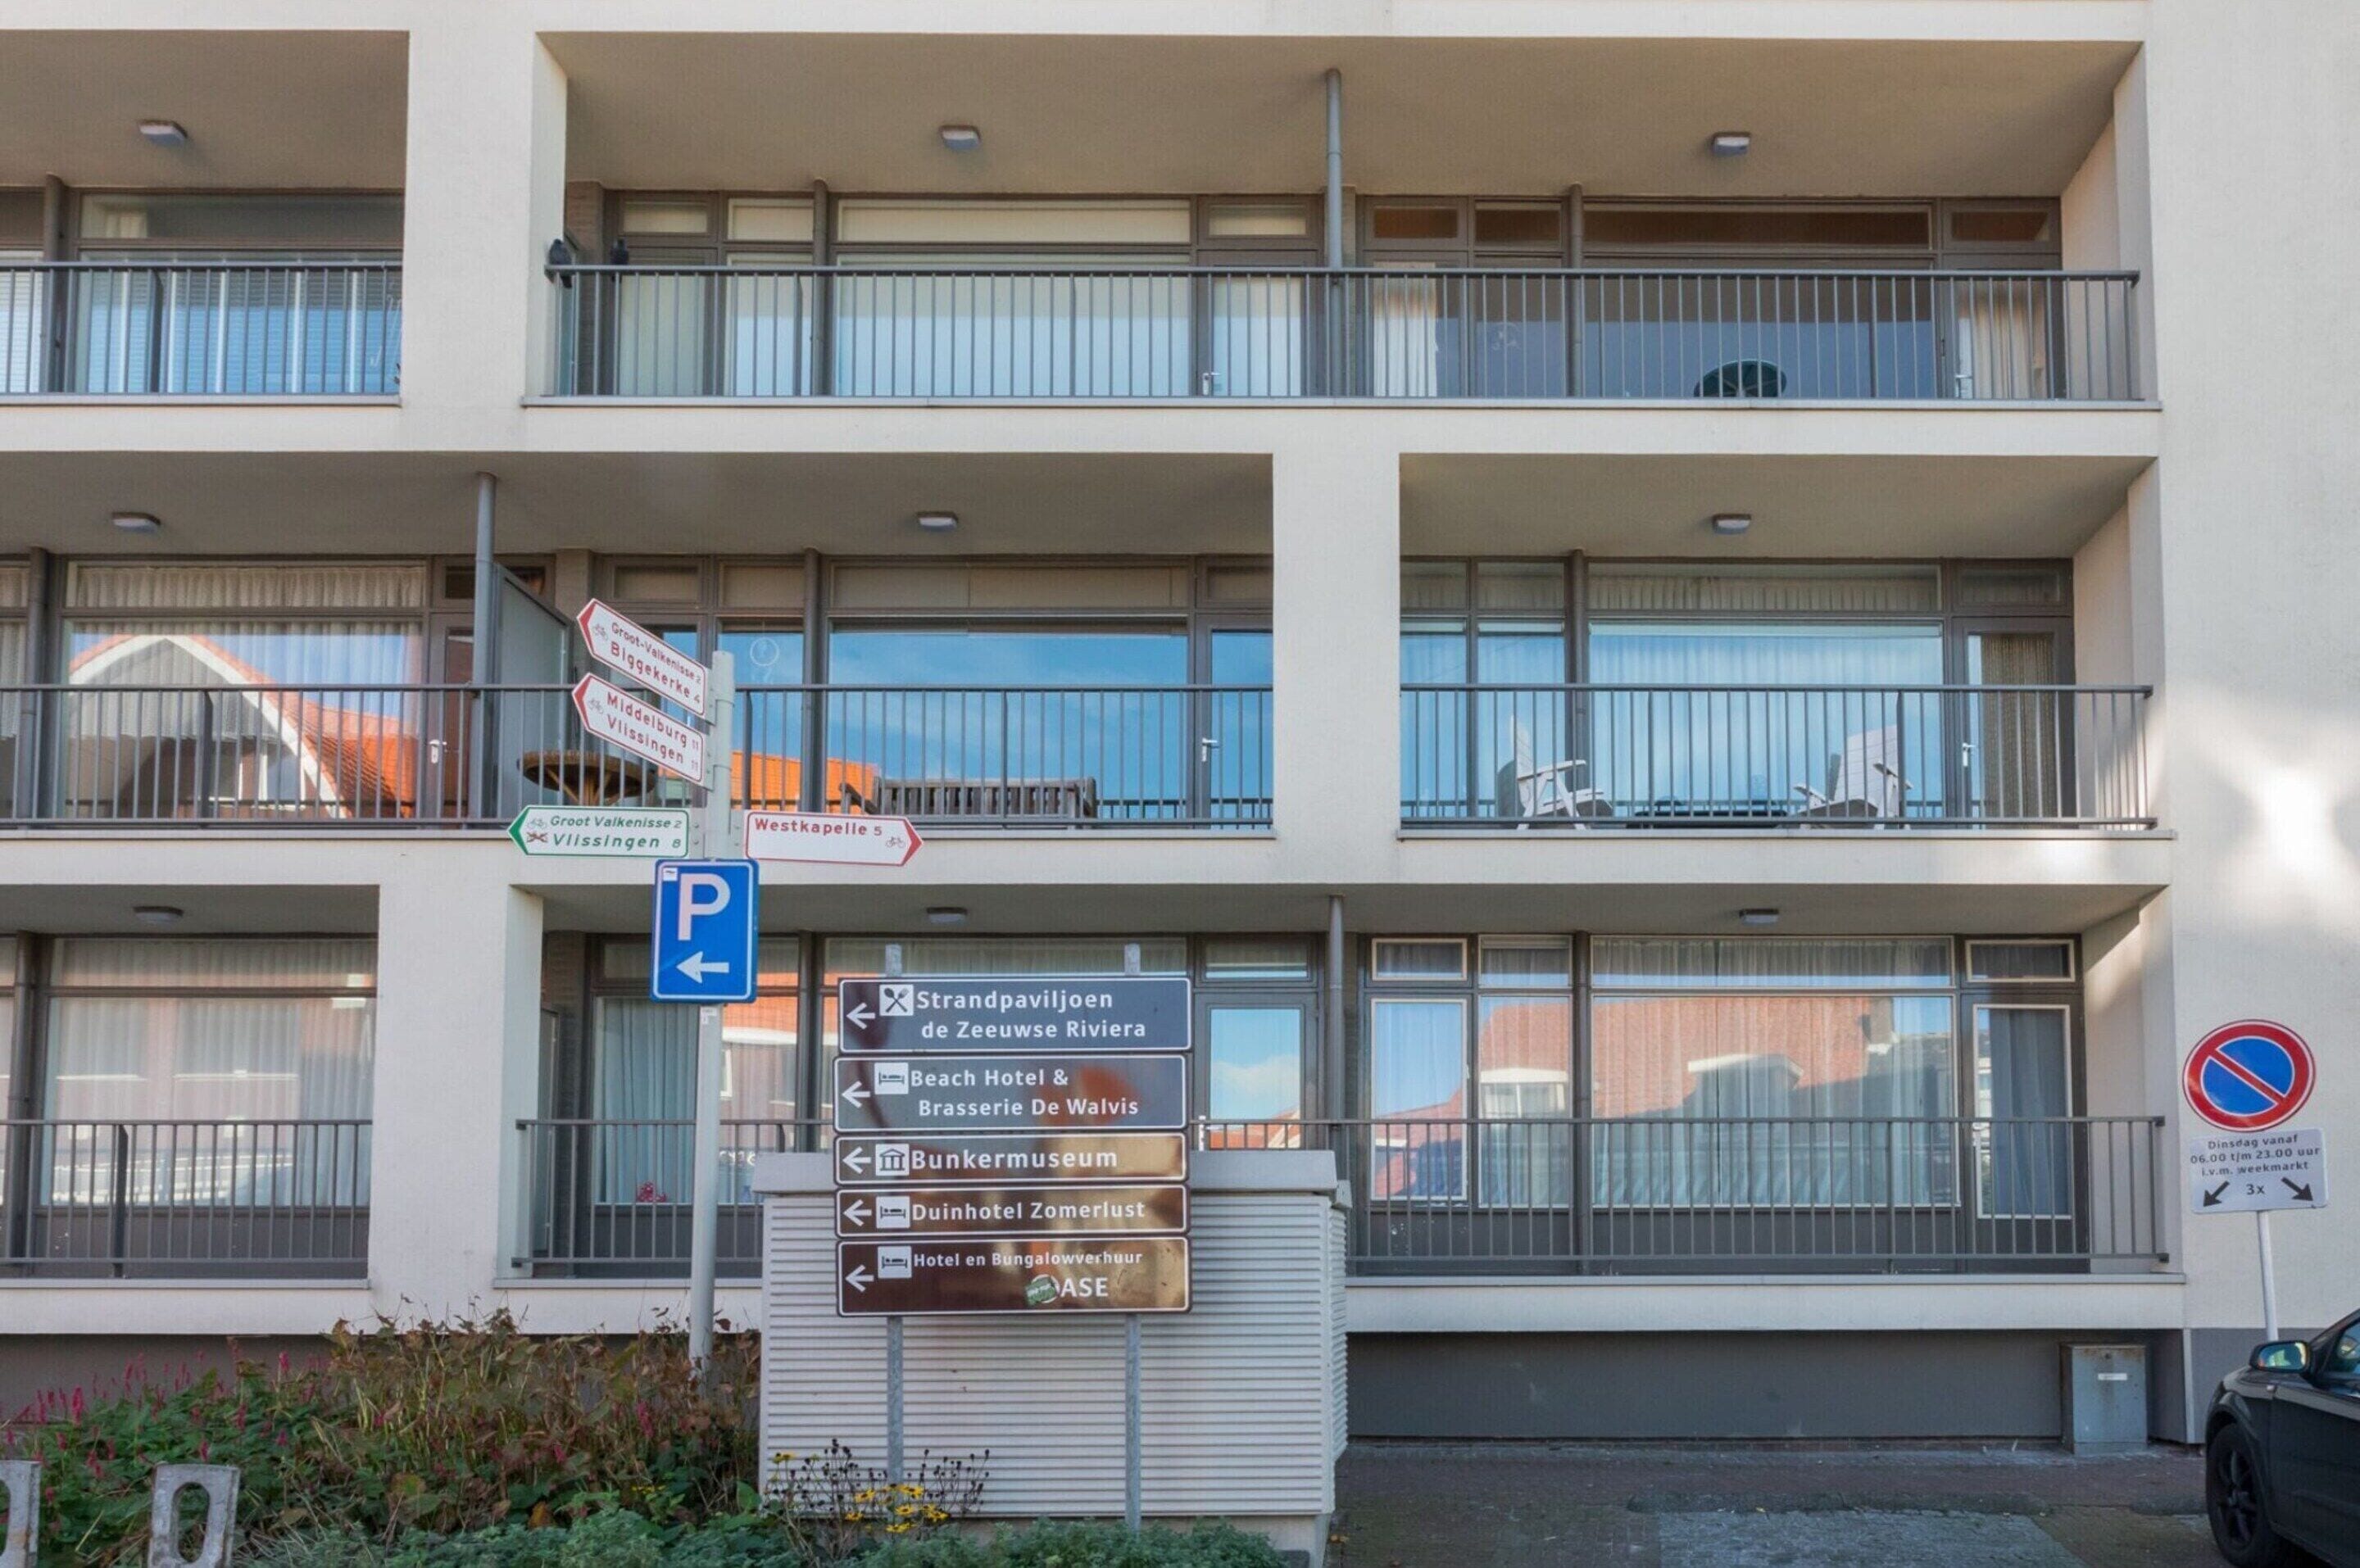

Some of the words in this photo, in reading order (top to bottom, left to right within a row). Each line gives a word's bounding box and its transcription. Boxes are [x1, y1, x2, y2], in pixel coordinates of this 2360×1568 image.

[611, 623, 695, 679] Groot-Valkenisse
[610, 641, 690, 698] Biggekerke
[607, 692, 687, 747] Middelburg
[607, 715, 683, 764] Vlissingen
[551, 816, 590, 827] Groot
[595, 817, 671, 828] Valkenisse
[673, 820, 682, 829] 2
[755, 818, 867, 836] Westkapelle
[874, 826, 883, 836] 5
[553, 834, 660, 851] Vlissingen
[678, 873, 731, 940] P
[916, 990, 1113, 1013] Strandpaviljoen
[921, 1022, 948, 1038] de
[956, 1022, 1058, 1038] Zeeuwse
[1066, 1020, 1146, 1037] Riviera
[910, 1070, 977, 1087] Beach
[984, 1069, 1045, 1086] Hotel
[1053, 1069, 1069, 1085] &
[919, 1099, 1023, 1117] Brasserie
[1032, 1099, 1060, 1115] De
[1067, 1098, 1139, 1115] Walvis
[2208, 1138, 2258, 1150] Dinsdag
[2262, 1135, 2299, 1145] vanaf
[911, 1149, 1118, 1170] Bunkermuseum
[2190, 1155, 2226, 1164] 06.00
[2231, 1152, 2252, 1163] t/m
[2256, 1149, 2293, 1160] 23.00
[2298, 1147, 2321, 1156] uur
[2202, 1167, 2234, 1176] i.v.m.
[2237, 1161, 2309, 1174] weekmarkt
[2246, 1184, 2265, 1195] 3x
[912, 1203, 1023, 1221] Duinhotel
[1030, 1202, 1146, 1219] Zomerlust
[914, 1253, 960, 1267] Hotel
[965, 1256, 986, 1266] en
[992, 1252, 1142, 1269] Bungalowverhuur
